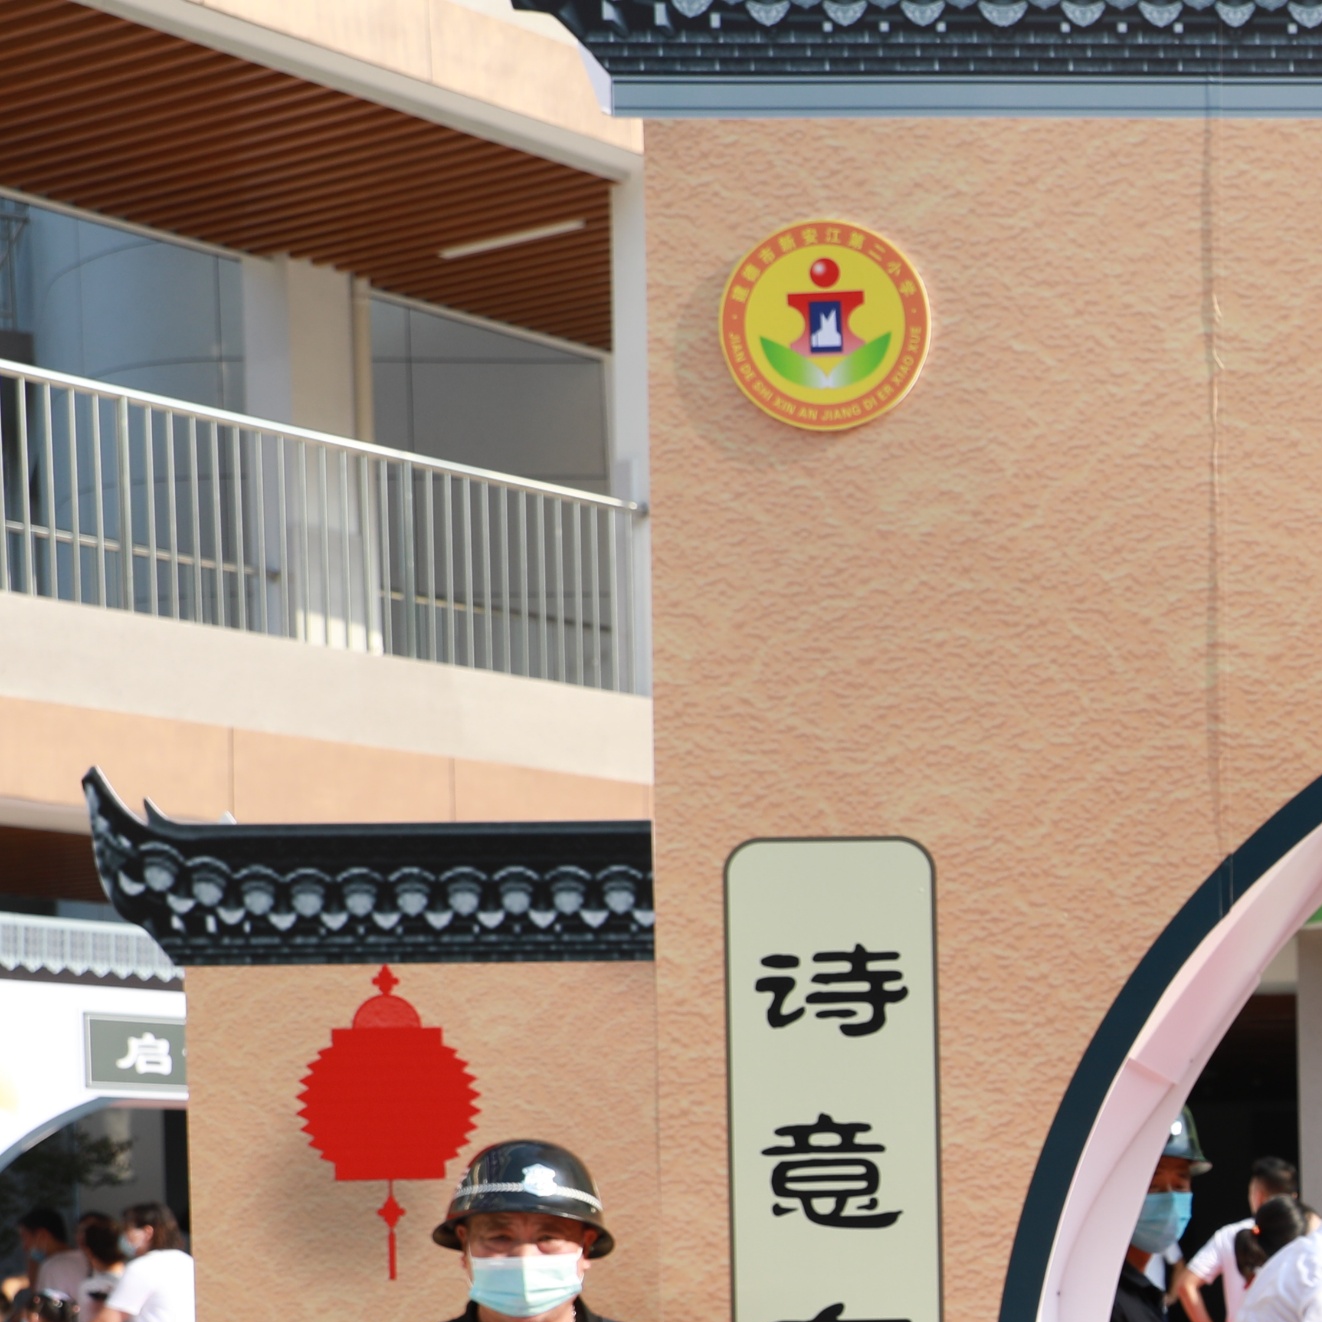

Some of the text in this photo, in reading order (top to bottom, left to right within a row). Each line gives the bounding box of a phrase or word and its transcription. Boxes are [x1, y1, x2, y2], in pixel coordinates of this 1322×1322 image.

[729, 332, 745, 362] JIAN
[753, 380, 772, 401] SHI
[773, 397, 796, 415] XIN
[799, 404, 818, 420] AN
[822, 405, 862, 421] JIANG
[863, 397, 879, 412] DI
[879, 382, 895, 401] ER
[892, 356, 915, 386] XIAO
[908, 326, 921, 353] XUE
[115, 1031, 186, 1075] 启
